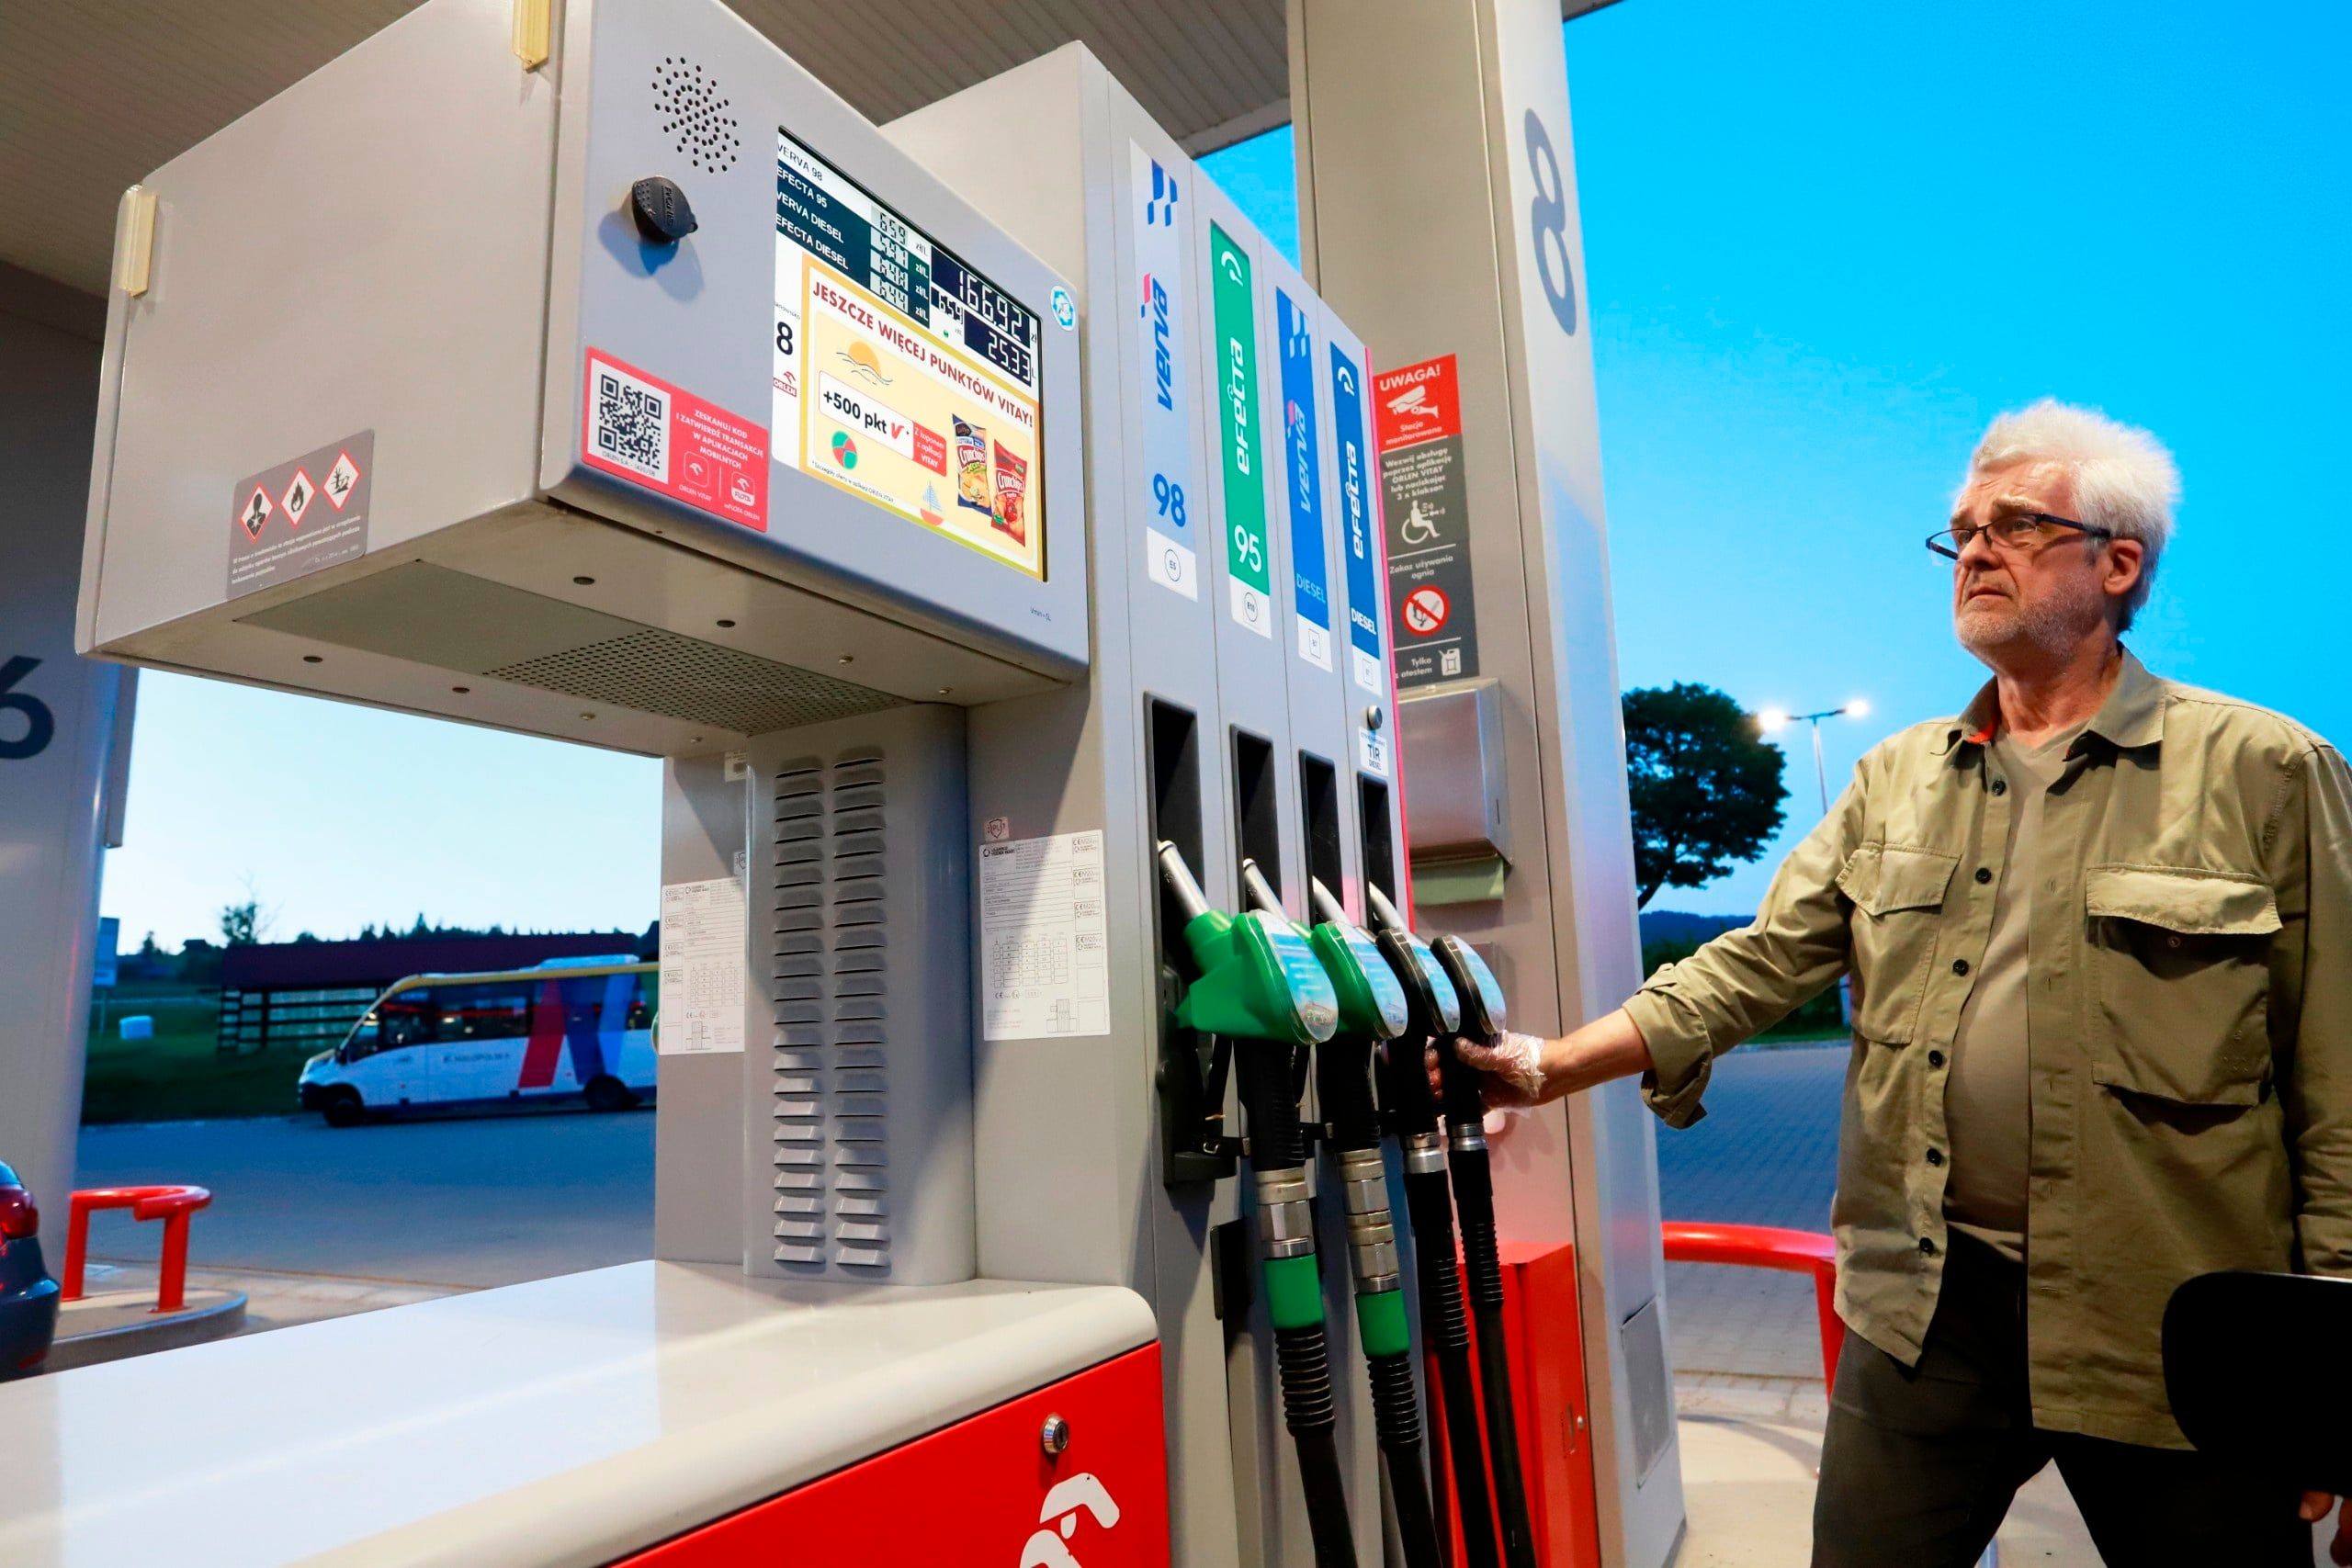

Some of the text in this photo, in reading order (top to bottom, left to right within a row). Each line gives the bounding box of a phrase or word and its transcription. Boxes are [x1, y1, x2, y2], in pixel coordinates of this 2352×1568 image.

[777, 144, 823, 182] VERVA 98
[777, 165, 828, 209] EFECTA 95
[776, 190, 844, 244] VERVA DIESEL
[1524, 107, 1577, 337] 8
[776, 213, 849, 270] EFECTA DIESEL
[776, 321, 794, 355] 8
[813, 280, 1034, 428] JESZCZE WIĘCEJ PUNKTÓW VITAY!
[1379, 364, 1441, 391] UWAGA!
[695, 410, 748, 439] ZESKANUJ KOD
[823, 389, 861, 420] +500
[865, 412, 888, 434] pkt
[1385, 425, 1442, 446] monitorowana
[1399, 421, 1424, 433] Stacja
[692, 431, 748, 461] W APLIKACJACH
[699, 446, 741, 469] MOBILNYCH
[1385, 454, 1415, 468] Wezwij
[1392, 464, 1443, 484] ORLEN VITAY
[1152, 473, 1187, 528] 98
[1390, 484, 1404, 492] lub
[1411, 484, 1444, 497] klakson
[1234, 525, 1262, 573] 95
[1389, 555, 1454, 575] Zakaz używania
[1411, 569, 1435, 581] ognia
[1296, 572, 1327, 605] DIESEL
[1351, 607, 1377, 636] DIESEL
[1401, 667, 1432, 678] atestem
[1411, 657, 1432, 668] Tylko
[0, 655, 54, 761] 6
[1367, 743, 1381, 761] TIR
